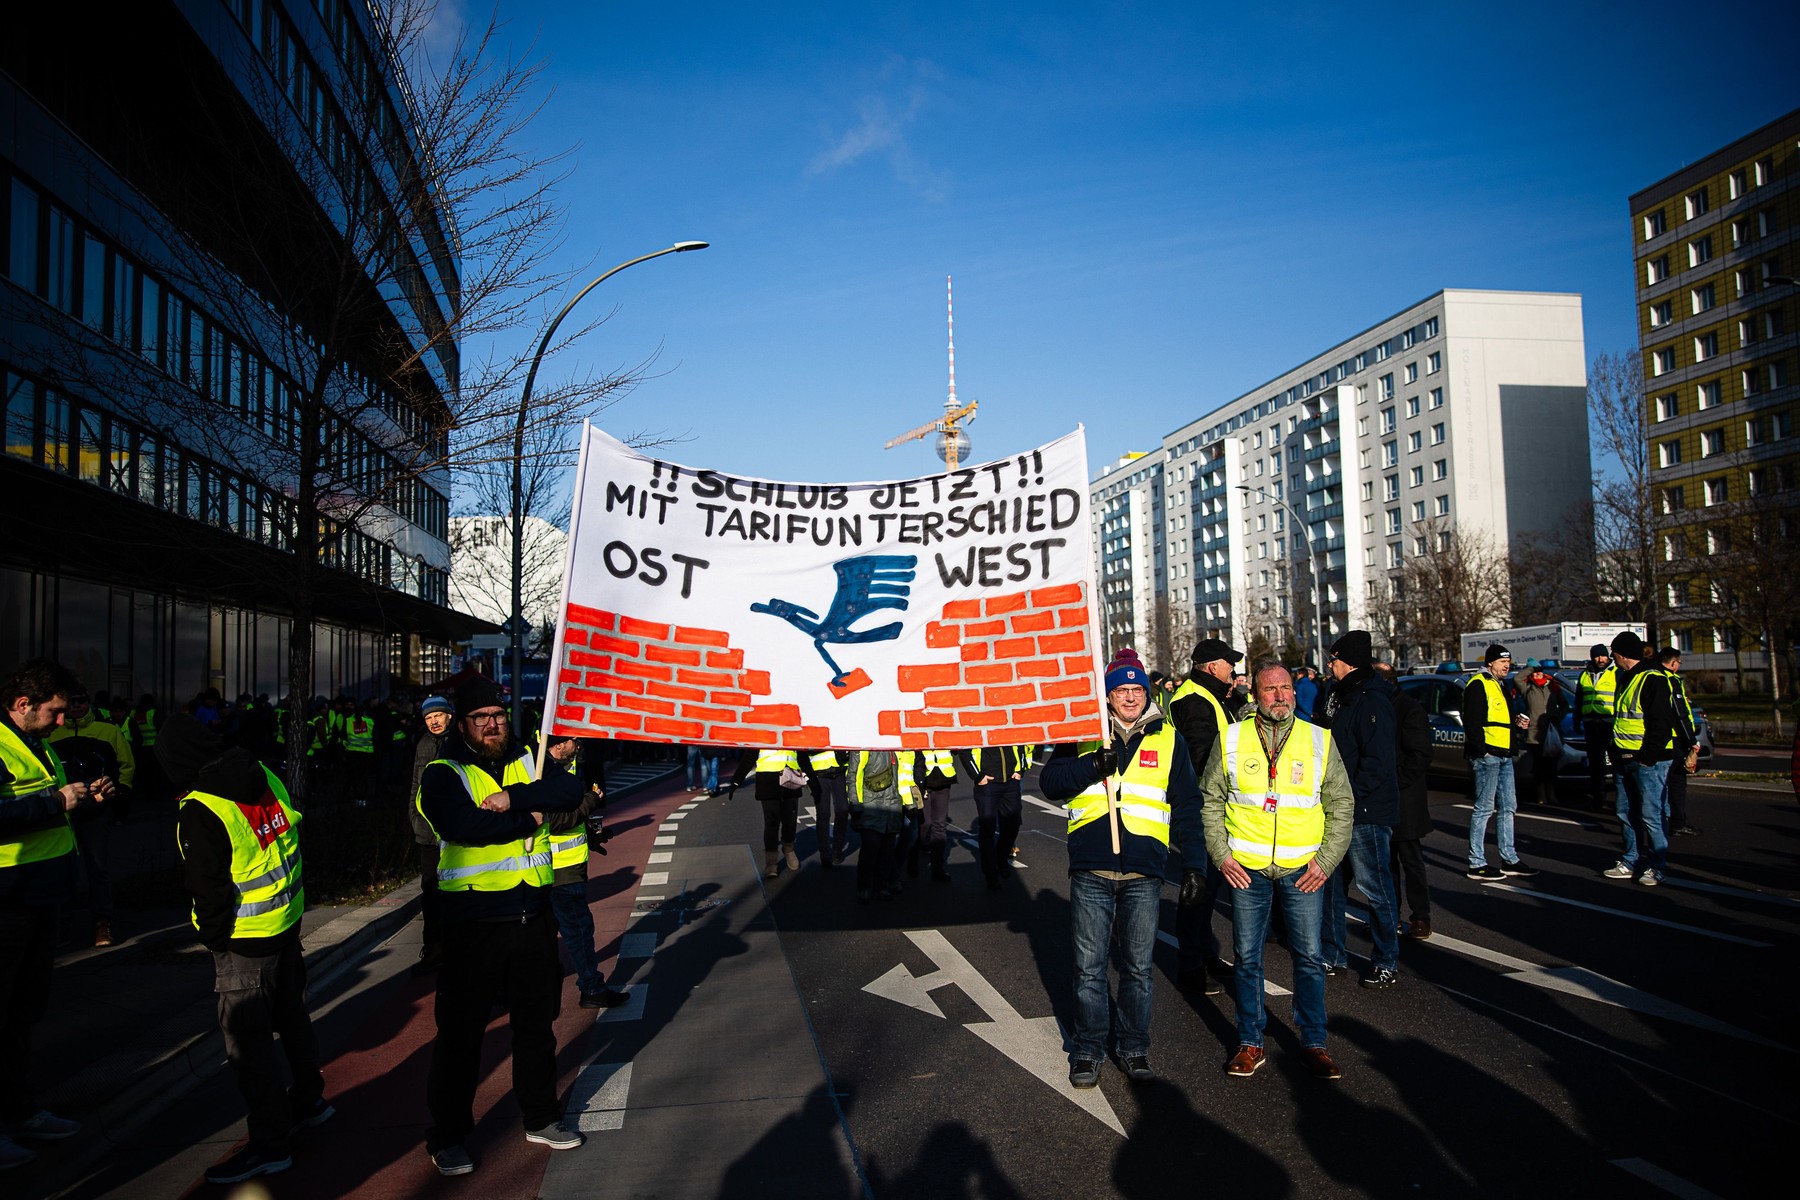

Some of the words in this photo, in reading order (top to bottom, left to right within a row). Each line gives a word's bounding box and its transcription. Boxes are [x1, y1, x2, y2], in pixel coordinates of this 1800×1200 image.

[606, 481, 679, 525] MIT
[696, 488, 1080, 547] TARIFUNTERSCHIED
[603, 540, 710, 599] OST
[935, 538, 1067, 588] WEST
